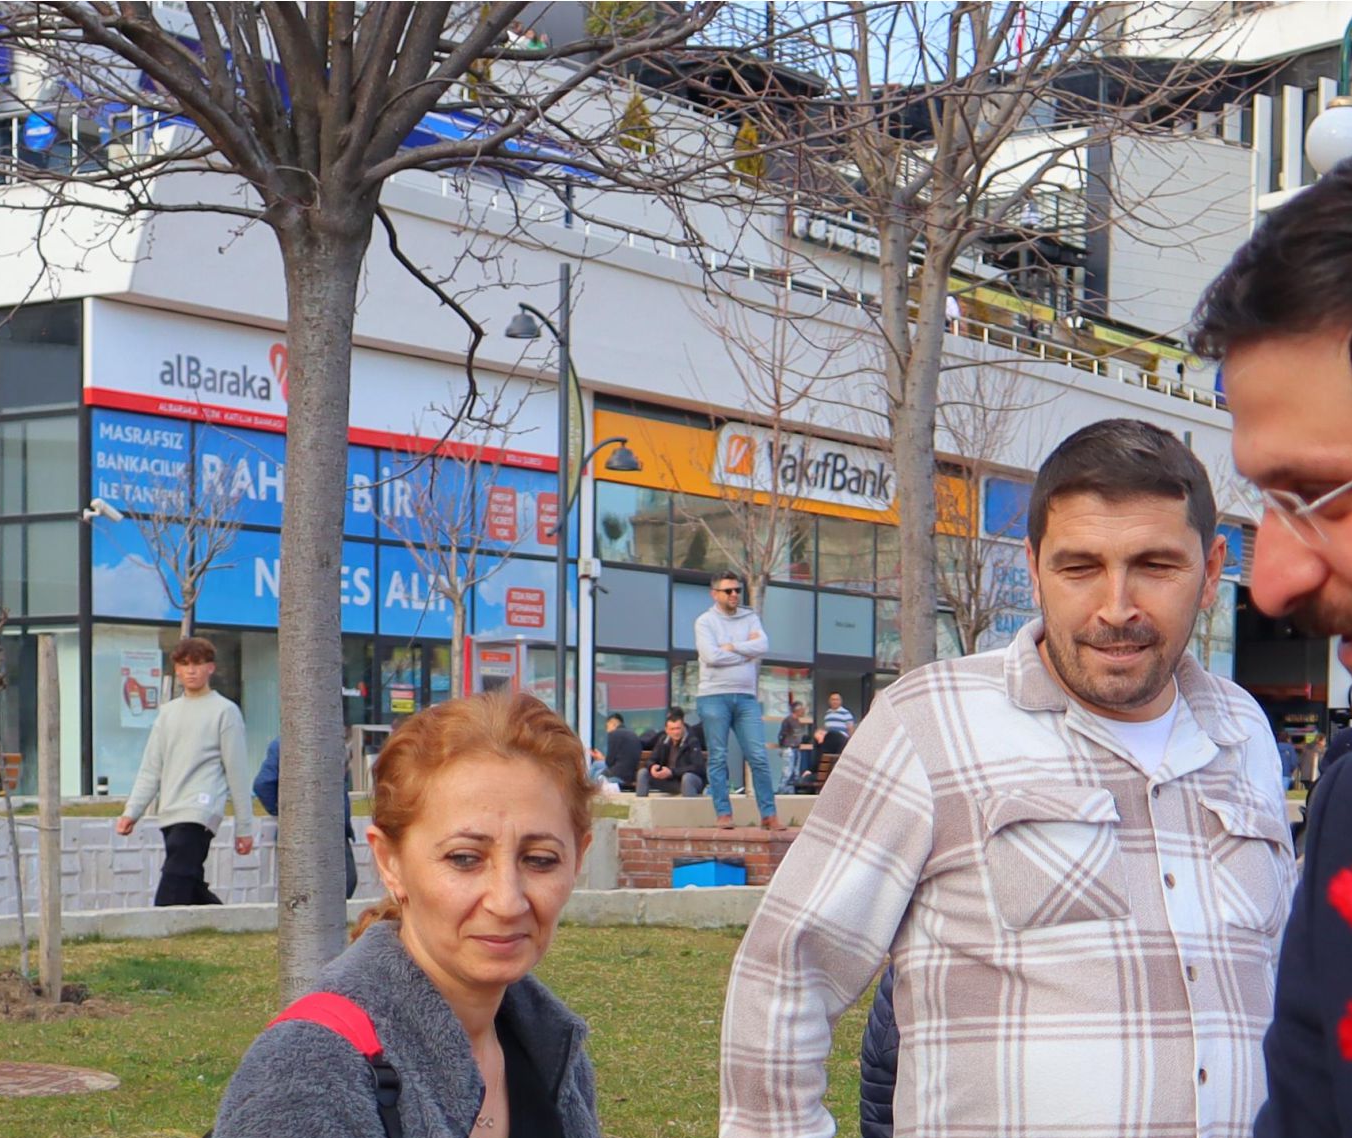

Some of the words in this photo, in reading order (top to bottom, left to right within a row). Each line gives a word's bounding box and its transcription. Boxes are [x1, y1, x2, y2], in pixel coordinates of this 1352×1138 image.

[159, 353, 271, 402] alBaraka
[99, 422, 184, 450] MASRAFSIZ
[99, 476, 120, 500] İLE
[202, 453, 284, 504] RAH
[352, 466, 414, 519] BİR
[769, 440, 892, 500] VakıfBank
[255, 557, 371, 607] NES
